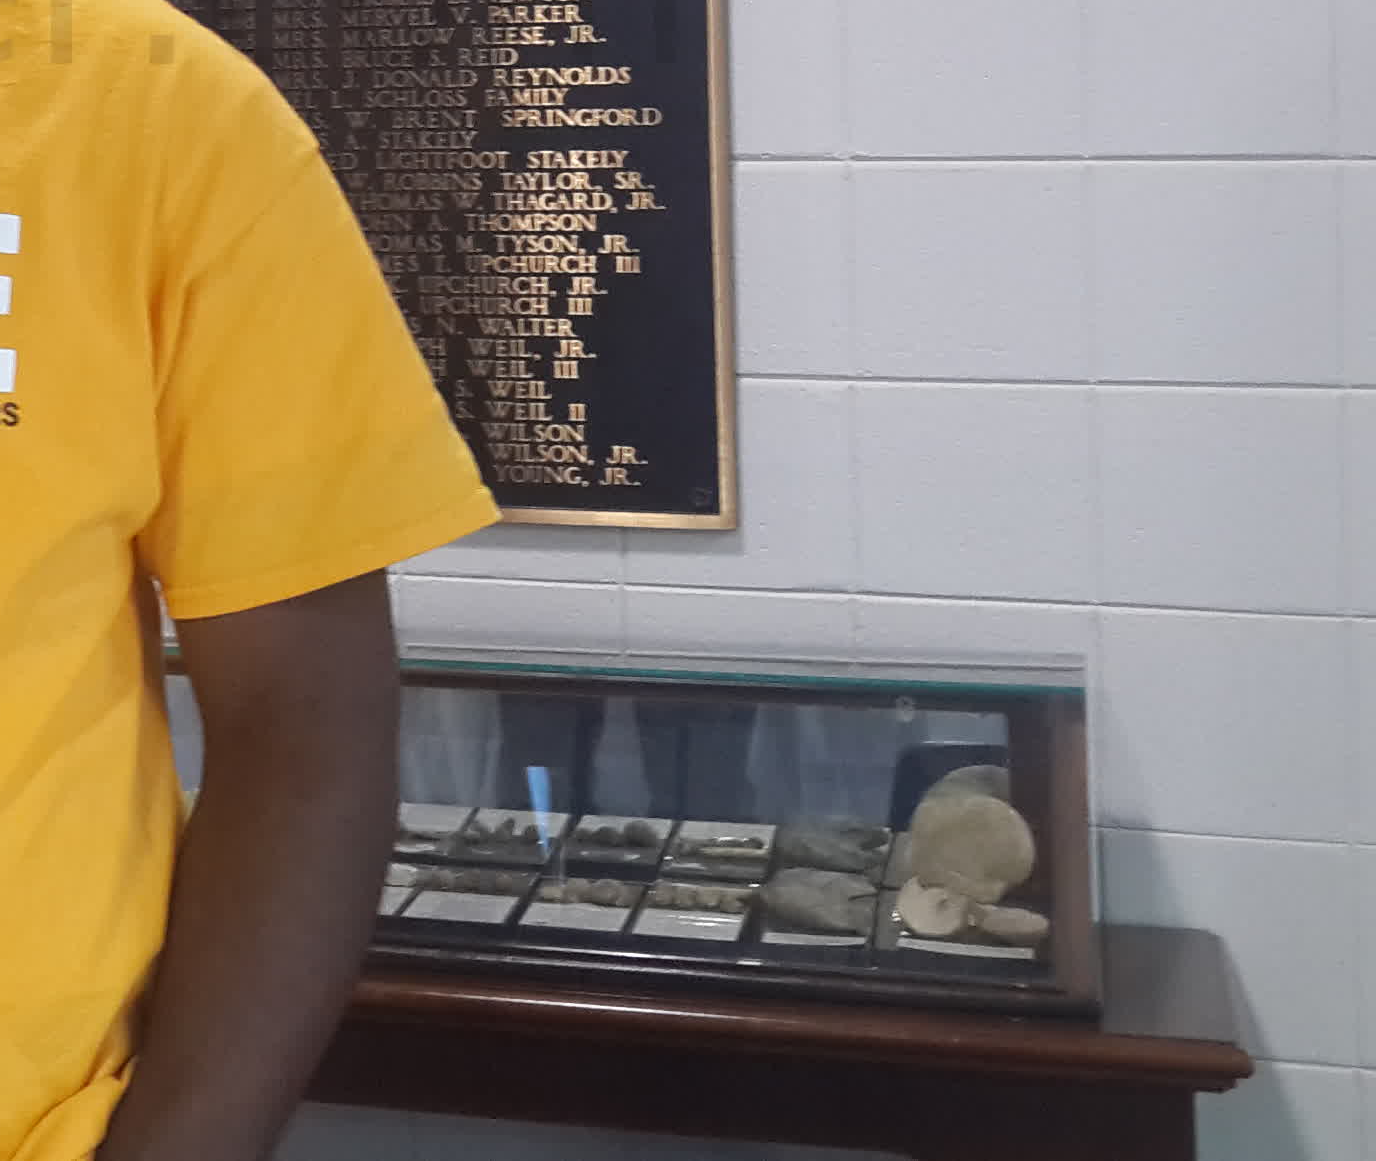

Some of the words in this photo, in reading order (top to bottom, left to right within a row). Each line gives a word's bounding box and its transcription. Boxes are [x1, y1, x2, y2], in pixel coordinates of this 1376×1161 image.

[272, 9, 328, 29] MRS.
[340, 5, 438, 27] MERVEL
[449, 6, 478, 25] V.
[488, 4, 584, 24] PARKER
[272, 30, 327, 49] MRS.
[341, 27, 456, 48] MARLOW
[472, 25, 556, 47] REESE,
[563, 24, 607, 44] JR.
[272, 50, 328, 69] MRS.
[341, 48, 413, 68] BRUCE
[428, 48, 447, 68] S.
[457, 47, 520, 67] REID
[373, 69, 480, 89] DONALD
[493, 66, 632, 87] REYNOLDS
[366, 89, 468, 108] SCHLOSS
[484, 87, 571, 107] FAMILY
[391, 109, 480, 129] BRENT
[500, 106, 663, 128] SPRINGFORD
[379, 130, 479, 150] STAKELY
[376, 150, 512, 171] LIGHTFOOT
[525, 149, 630, 169] STAKELY
[383, 171, 483, 191] ROBBINS
[499, 171, 603, 192] TAYLOR,
[612, 170, 656, 190] SR.
[454, 192, 484, 211] W.
[491, 191, 619, 214] THAGARD,
[625, 191, 668, 211] JR.
[426, 213, 449, 232] A.
[464, 213, 598, 232] THOMPSON
[455, 234, 484, 254] M.
[494, 234, 587, 255] TYSON,
[598, 234, 641, 254] JR.
[464, 255, 598, 274] UPCHURCH
[615, 255, 641, 274] III
[418, 275, 557, 297] UPCHURCH,
[566, 276, 609, 295] JR.
[419, 296, 550, 315] UPCHURCH
[567, 297, 593, 316] III
[436, 316, 465, 336] N.
[477, 317, 577, 337] WALTER
[466, 337, 542, 360] WEIL,
[552, 339, 598, 359] JR.
[465, 359, 535, 379] WEIL
[552, 360, 579, 380] III
[487, 379, 552, 399] WEIL
[484, 400, 553, 421] WEIL
[567, 402, 588, 422] II
[480, 422, 585, 443] WILSON
[487, 442, 595, 466] WILSON,
[605, 445, 648, 465] JR.
[493, 464, 591, 488] YOUNG,
[599, 466, 642, 487] JR.
